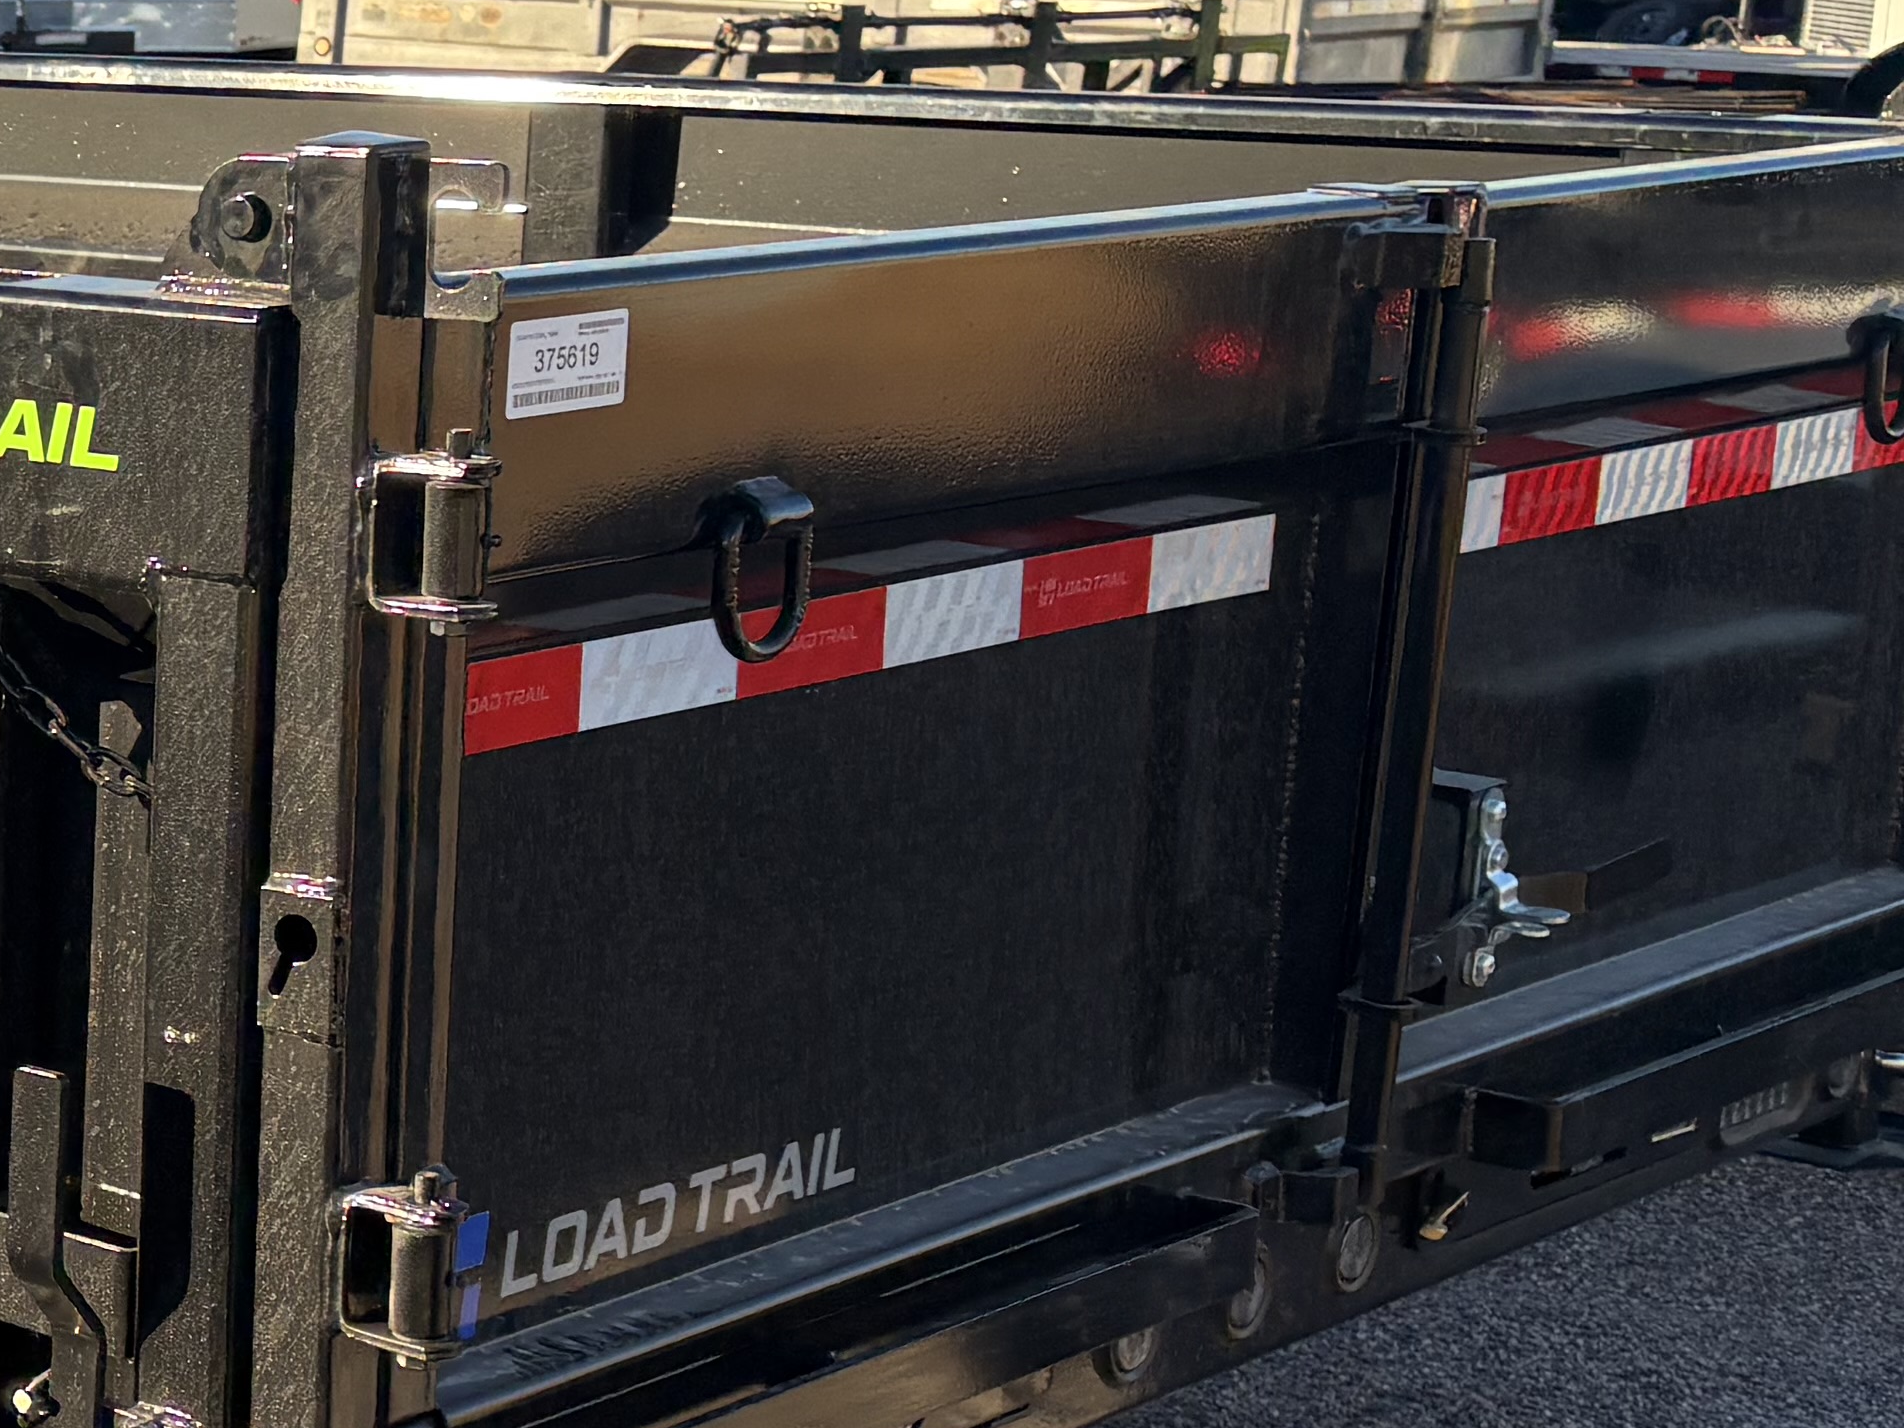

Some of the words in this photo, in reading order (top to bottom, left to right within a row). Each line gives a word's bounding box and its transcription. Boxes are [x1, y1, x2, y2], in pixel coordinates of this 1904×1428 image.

[534, 342, 599, 373] 375619
[501, 1181, 677, 1298] LOAD
[689, 1127, 856, 1233] TRAIL
